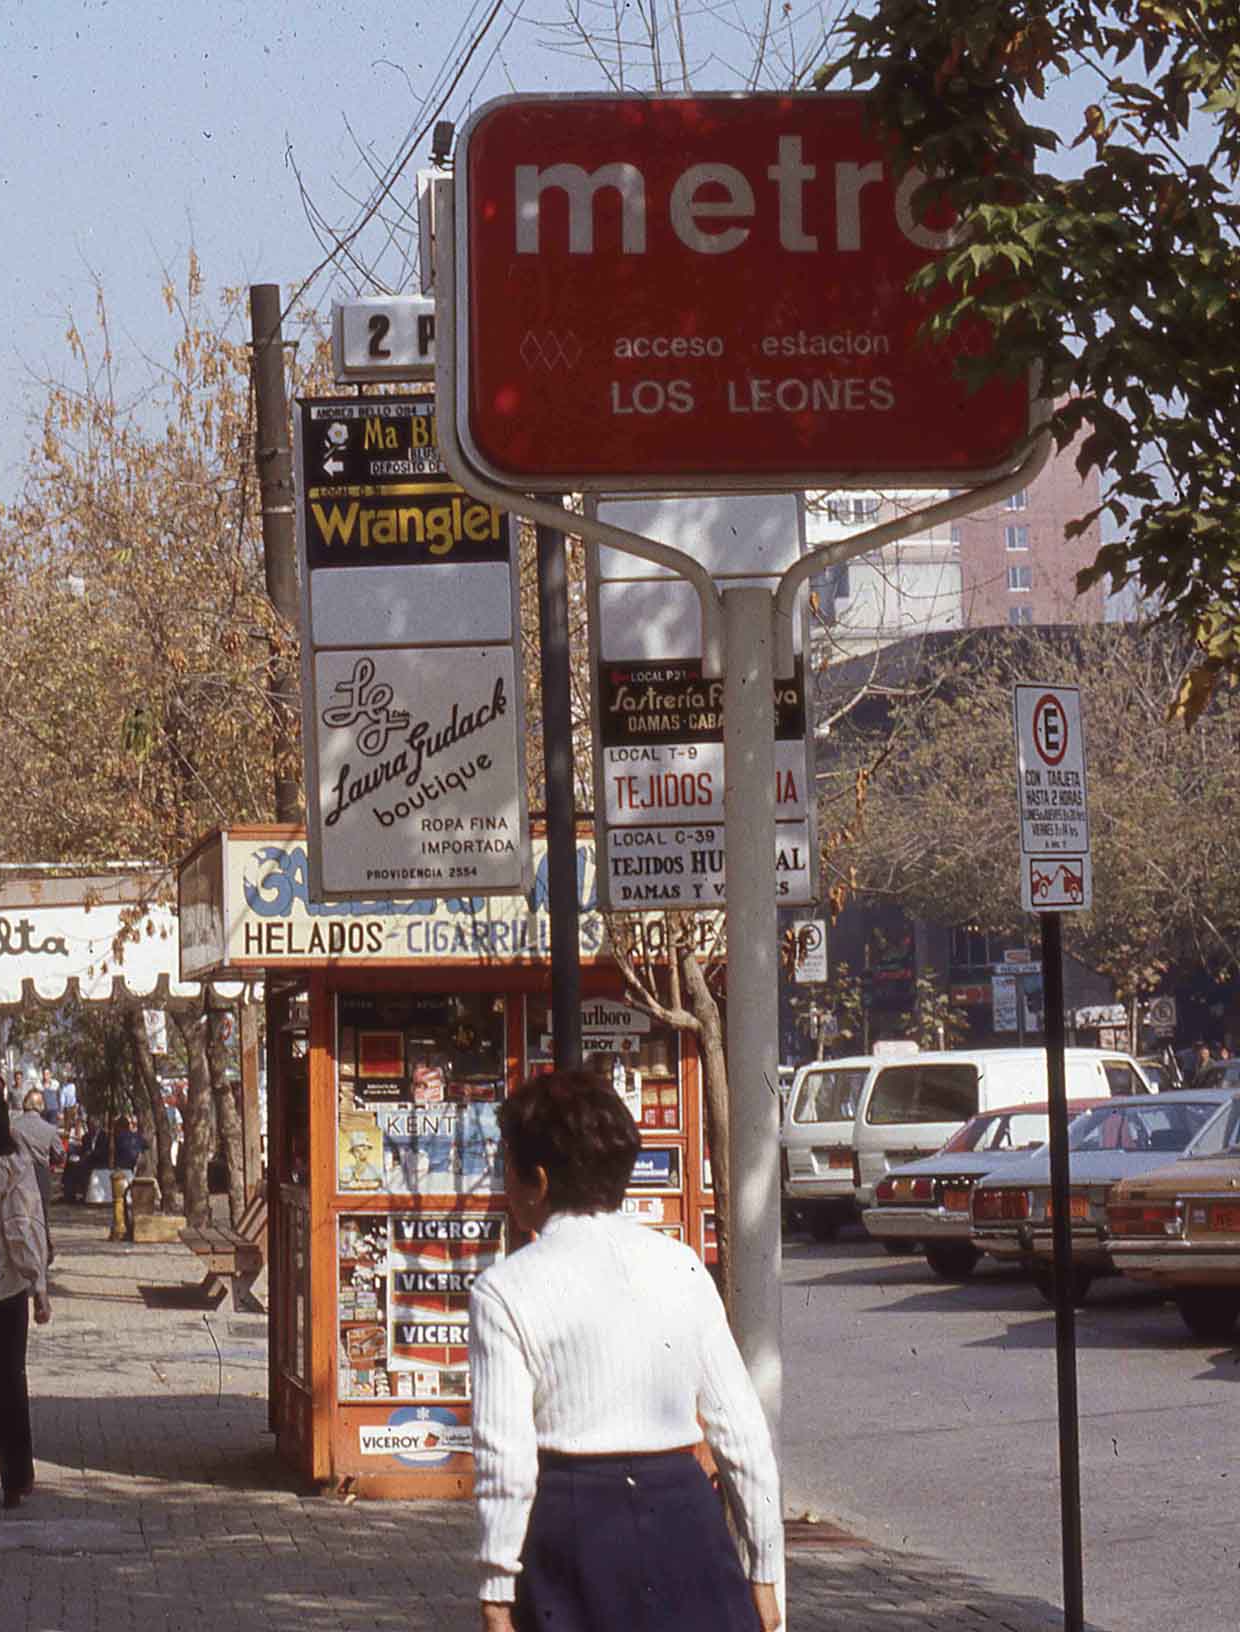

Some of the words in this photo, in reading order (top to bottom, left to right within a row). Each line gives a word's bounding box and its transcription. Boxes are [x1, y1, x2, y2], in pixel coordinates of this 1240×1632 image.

[368, 314, 391, 358] 2
[614, 336, 724, 358] acceso
[610, 380, 695, 414] LOS
[728, 376, 896, 413] LEONES
[363, 415, 400, 450] Ma
[311, 498, 503, 555] Wrangler
[631, 671, 664, 682] LOCAL
[628, 714, 681, 732] DAMAS
[1044, 708, 1059, 750] E
[610, 747, 660, 762] LOCAL
[668, 746, 698, 761] T-9
[324, 750, 409, 827] Laura
[372, 754, 492, 827] boutique
[613, 772, 713, 809] TEJIDOS
[421, 817, 464, 832] ROPA
[470, 816, 509, 831] FINA
[421, 839, 515, 855] IMPORTADA
[613, 831, 667, 847] LOCAL
[675, 830, 715, 845] C-39
[366, 869, 443, 881] PROVIDENCIA
[612, 856, 685, 876] TEJIDOS
[622, 884, 681, 901] DAMAS
[406, 919, 601, 954] CIGARRILLS
[386, 1115, 458, 1135] KENT
[401, 1220, 493, 1239] VICEROY
[362, 1436, 420, 1449] VICEROY
